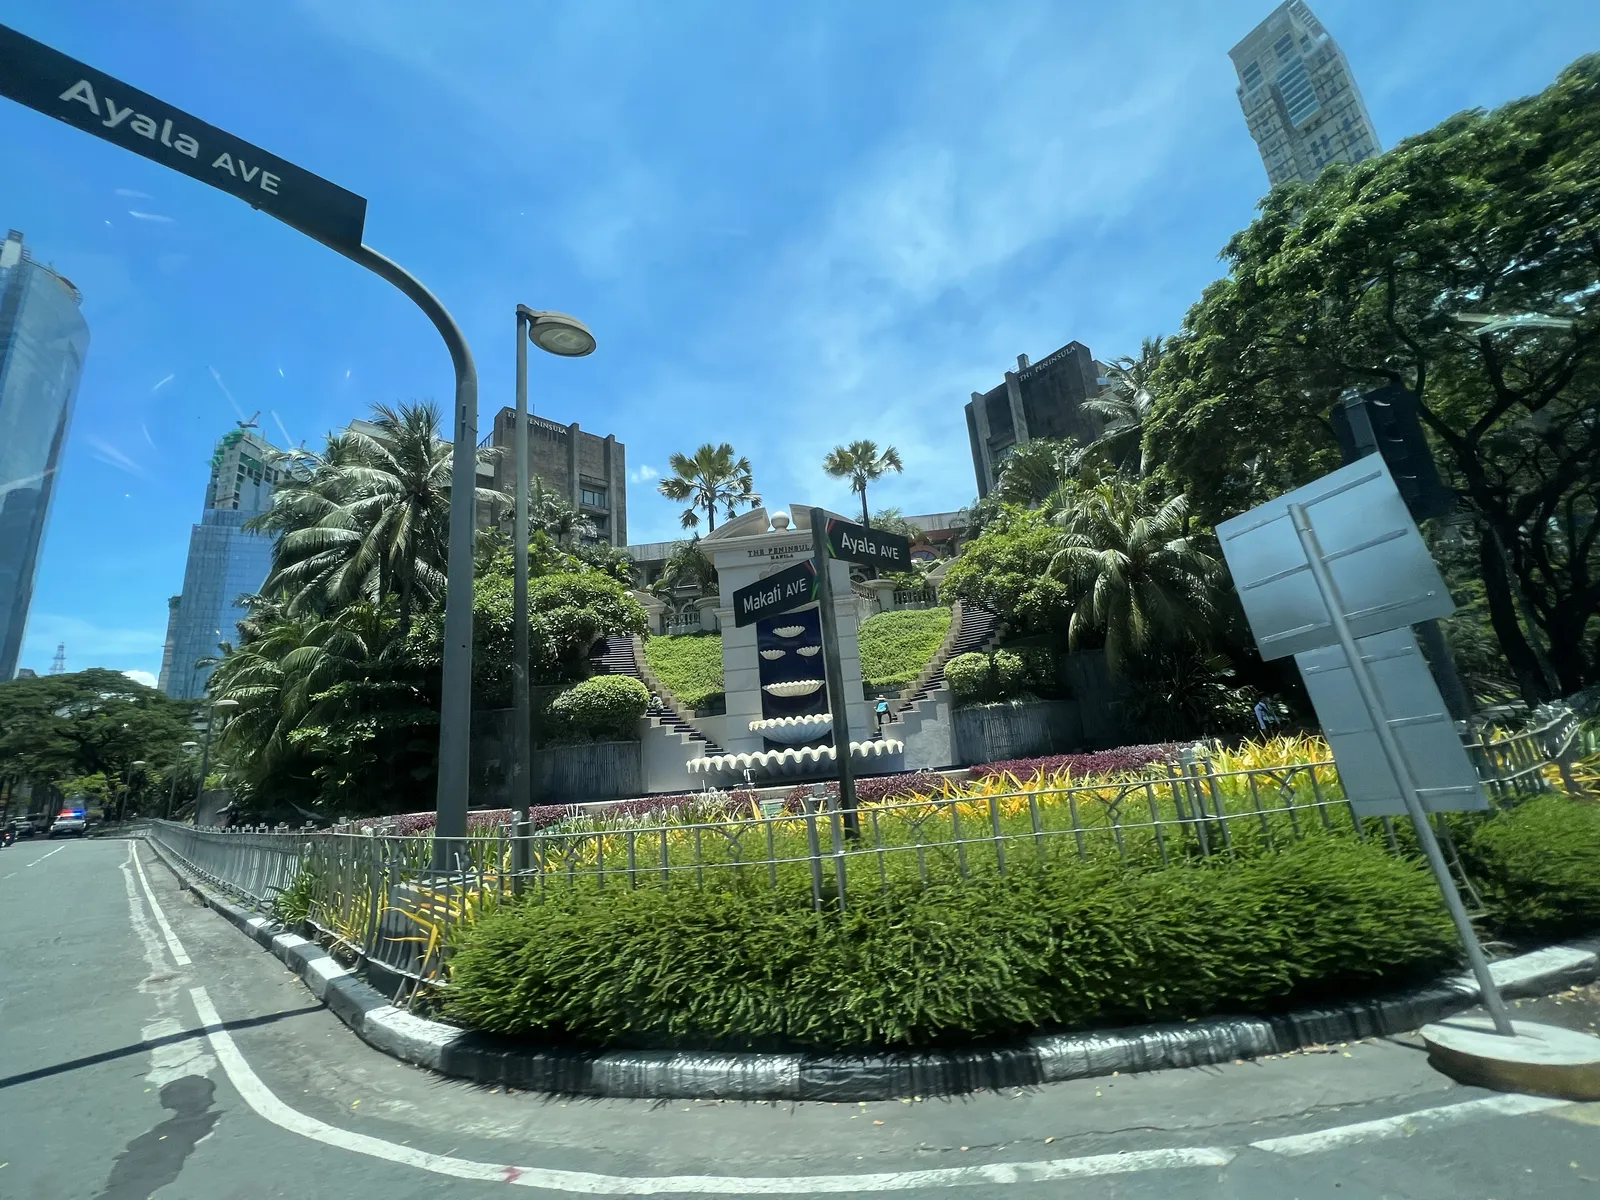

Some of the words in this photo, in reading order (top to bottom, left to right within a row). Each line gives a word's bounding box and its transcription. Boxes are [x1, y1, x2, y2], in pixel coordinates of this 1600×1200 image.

[59, 79, 200, 159] Ayala
[212, 153, 282, 195] AVE
[1034, 345, 1076, 373] PENINSULA
[528, 418, 567, 435] ENINSULA
[747, 549, 764, 558] THE
[841, 532, 877, 555] Ayala
[880, 545, 900, 560] AVE
[743, 583, 781, 614] Makati
[786, 578, 807, 598] AVE
